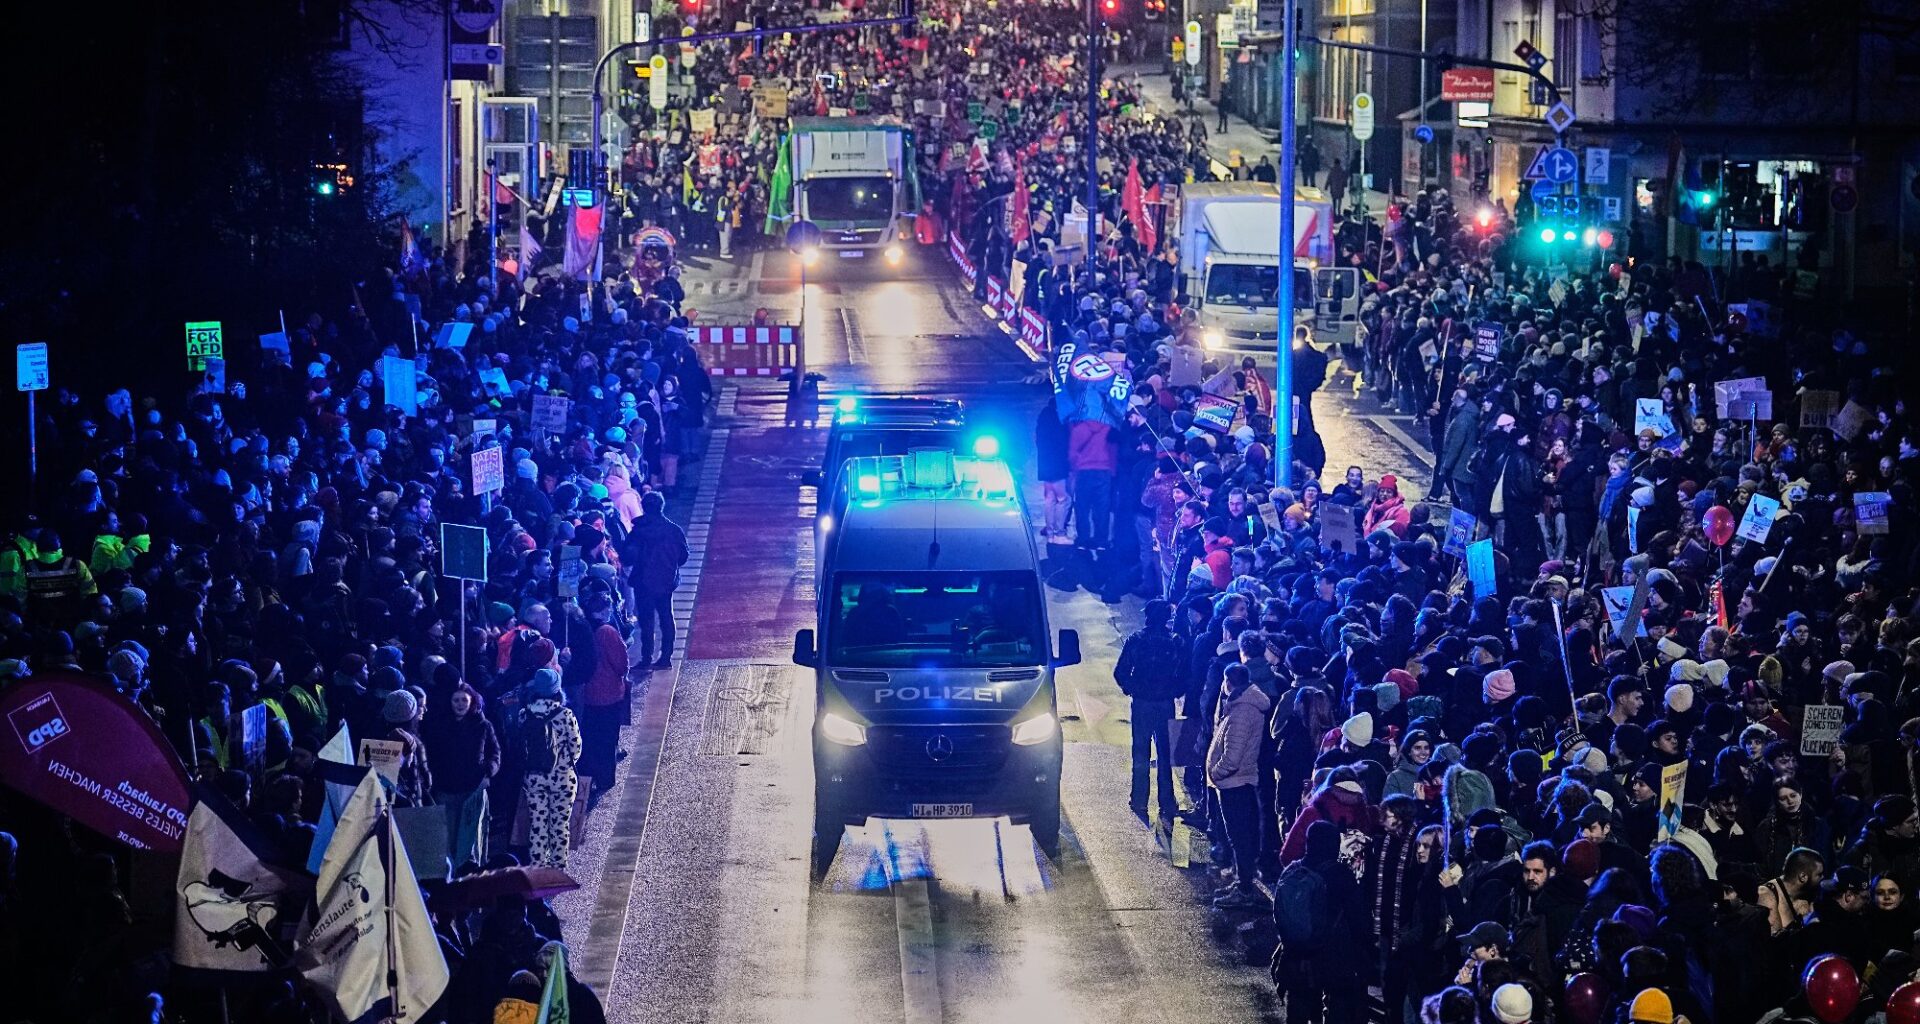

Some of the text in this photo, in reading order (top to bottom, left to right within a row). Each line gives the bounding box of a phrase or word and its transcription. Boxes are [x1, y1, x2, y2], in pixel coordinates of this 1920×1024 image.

[188, 332, 219, 343] FCK
[189, 343, 220, 354] AFD
[1803, 414, 1836, 426] BUNT
[874, 686, 1002, 703] POLIZEI
[1807, 707, 1842, 720] SCHEREN
[913, 804, 972, 815] WI HP 3910
